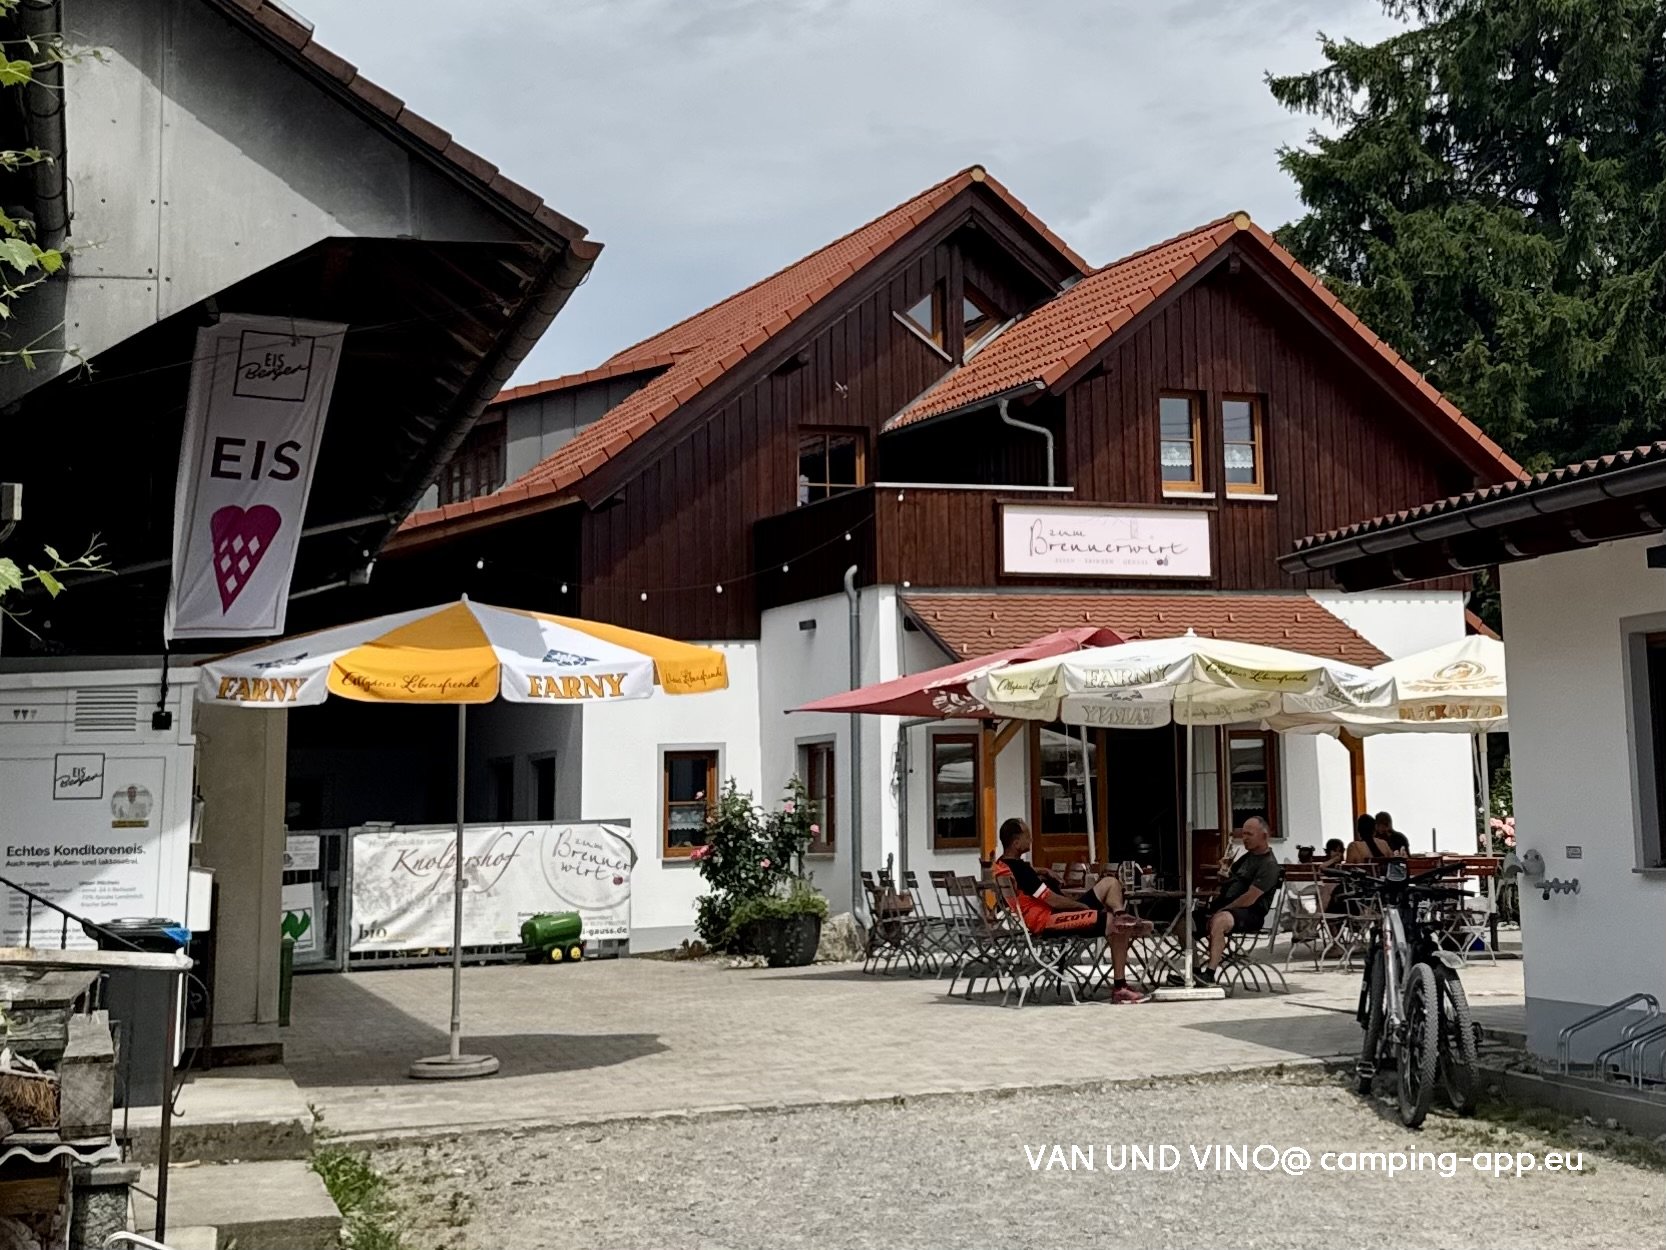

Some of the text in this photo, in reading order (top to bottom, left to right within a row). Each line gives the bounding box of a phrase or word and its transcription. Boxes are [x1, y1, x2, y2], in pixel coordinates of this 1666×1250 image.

[264, 352, 285, 368] EIS
[211, 436, 302, 481] EIS
[1029, 518, 1189, 557] Brennerwirt
[1049, 529, 1086, 537] zum
[215, 675, 308, 702] FARNY
[526, 672, 629, 699] FARNY
[1083, 663, 1172, 688] FARNY
[72, 766, 87, 778] EIS
[6, 842, 147, 858] Echtes Konditoreneis.
[391, 830, 535, 893] Knolprshof
[552, 827, 632, 872] Brenner
[560, 861, 611, 881] wirt
